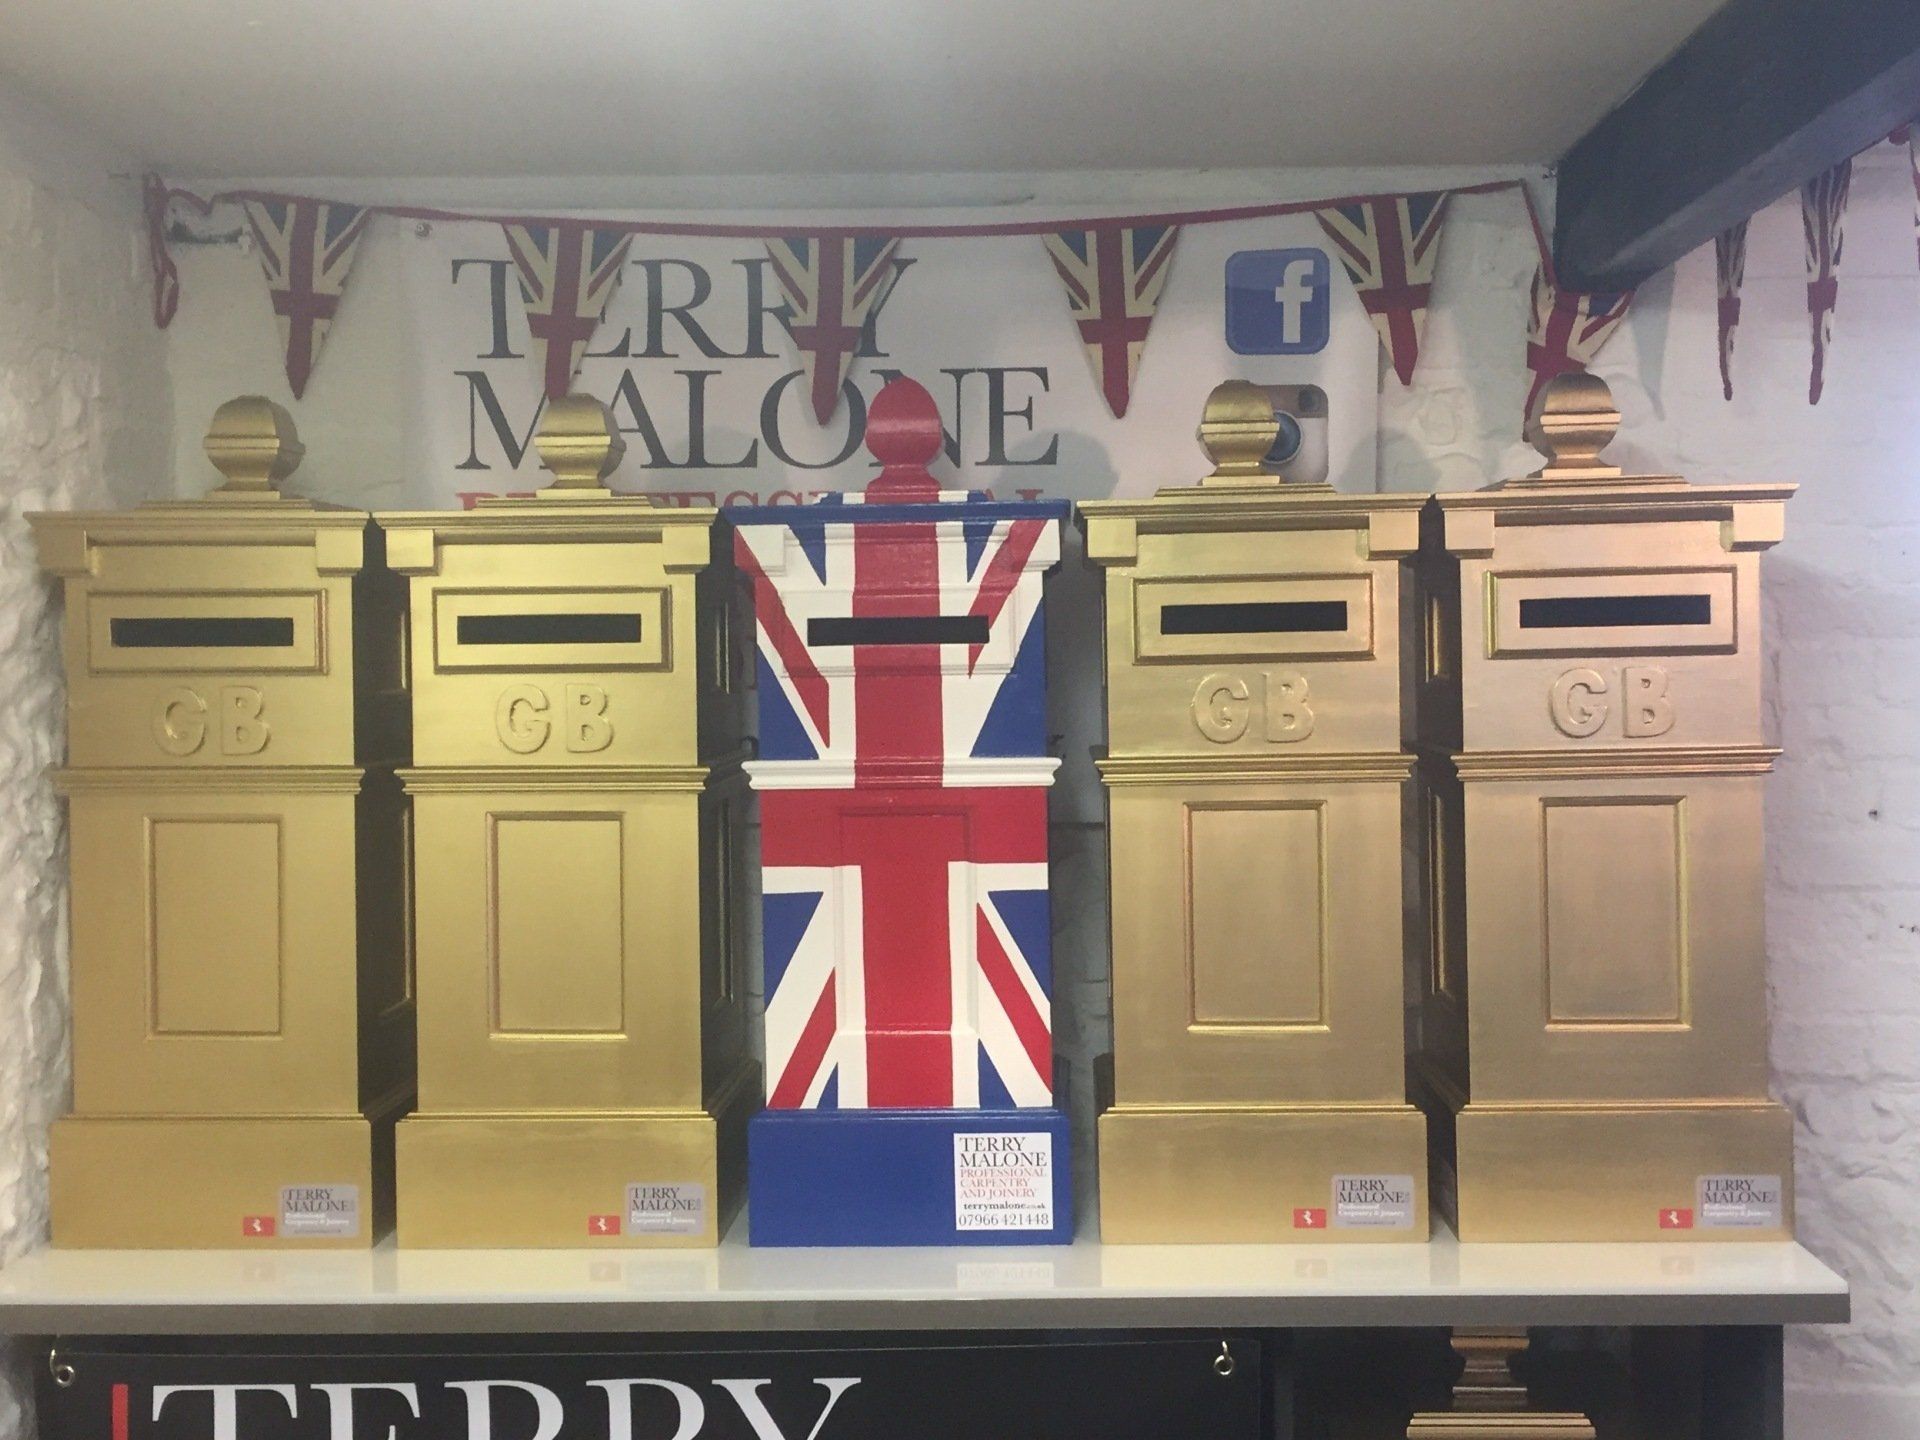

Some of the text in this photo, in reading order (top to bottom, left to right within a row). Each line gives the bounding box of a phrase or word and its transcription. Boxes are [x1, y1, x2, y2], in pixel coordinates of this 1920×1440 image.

[1190, 671, 1315, 744] GB
[1548, 666, 1677, 739] GB
[151, 685, 271, 757] GB
[496, 683, 615, 755] GB
[960, 1137, 1025, 1152] TERRY
[960, 1152, 1047, 1168] MALONE
[960, 1168, 1047, 1178] PROFESSIONAL
[960, 1179, 1030, 1188] CARPENTRY
[1338, 1179, 1388, 1191] TERRY
[1704, 1179, 1754, 1191] TERRY
[286, 1188, 334, 1200] TERRY
[632, 1187, 680, 1199] TERRY
[960, 1188, 1036, 1200] AND JOINERY
[1338, 1191, 1405, 1203] MALONE
[1704, 1191, 1773, 1203] MALONE
[286, 1200, 350, 1212] MALONE
[632, 1199, 696, 1211] MALONE
[959, 1214, 999, 1226] 07966
